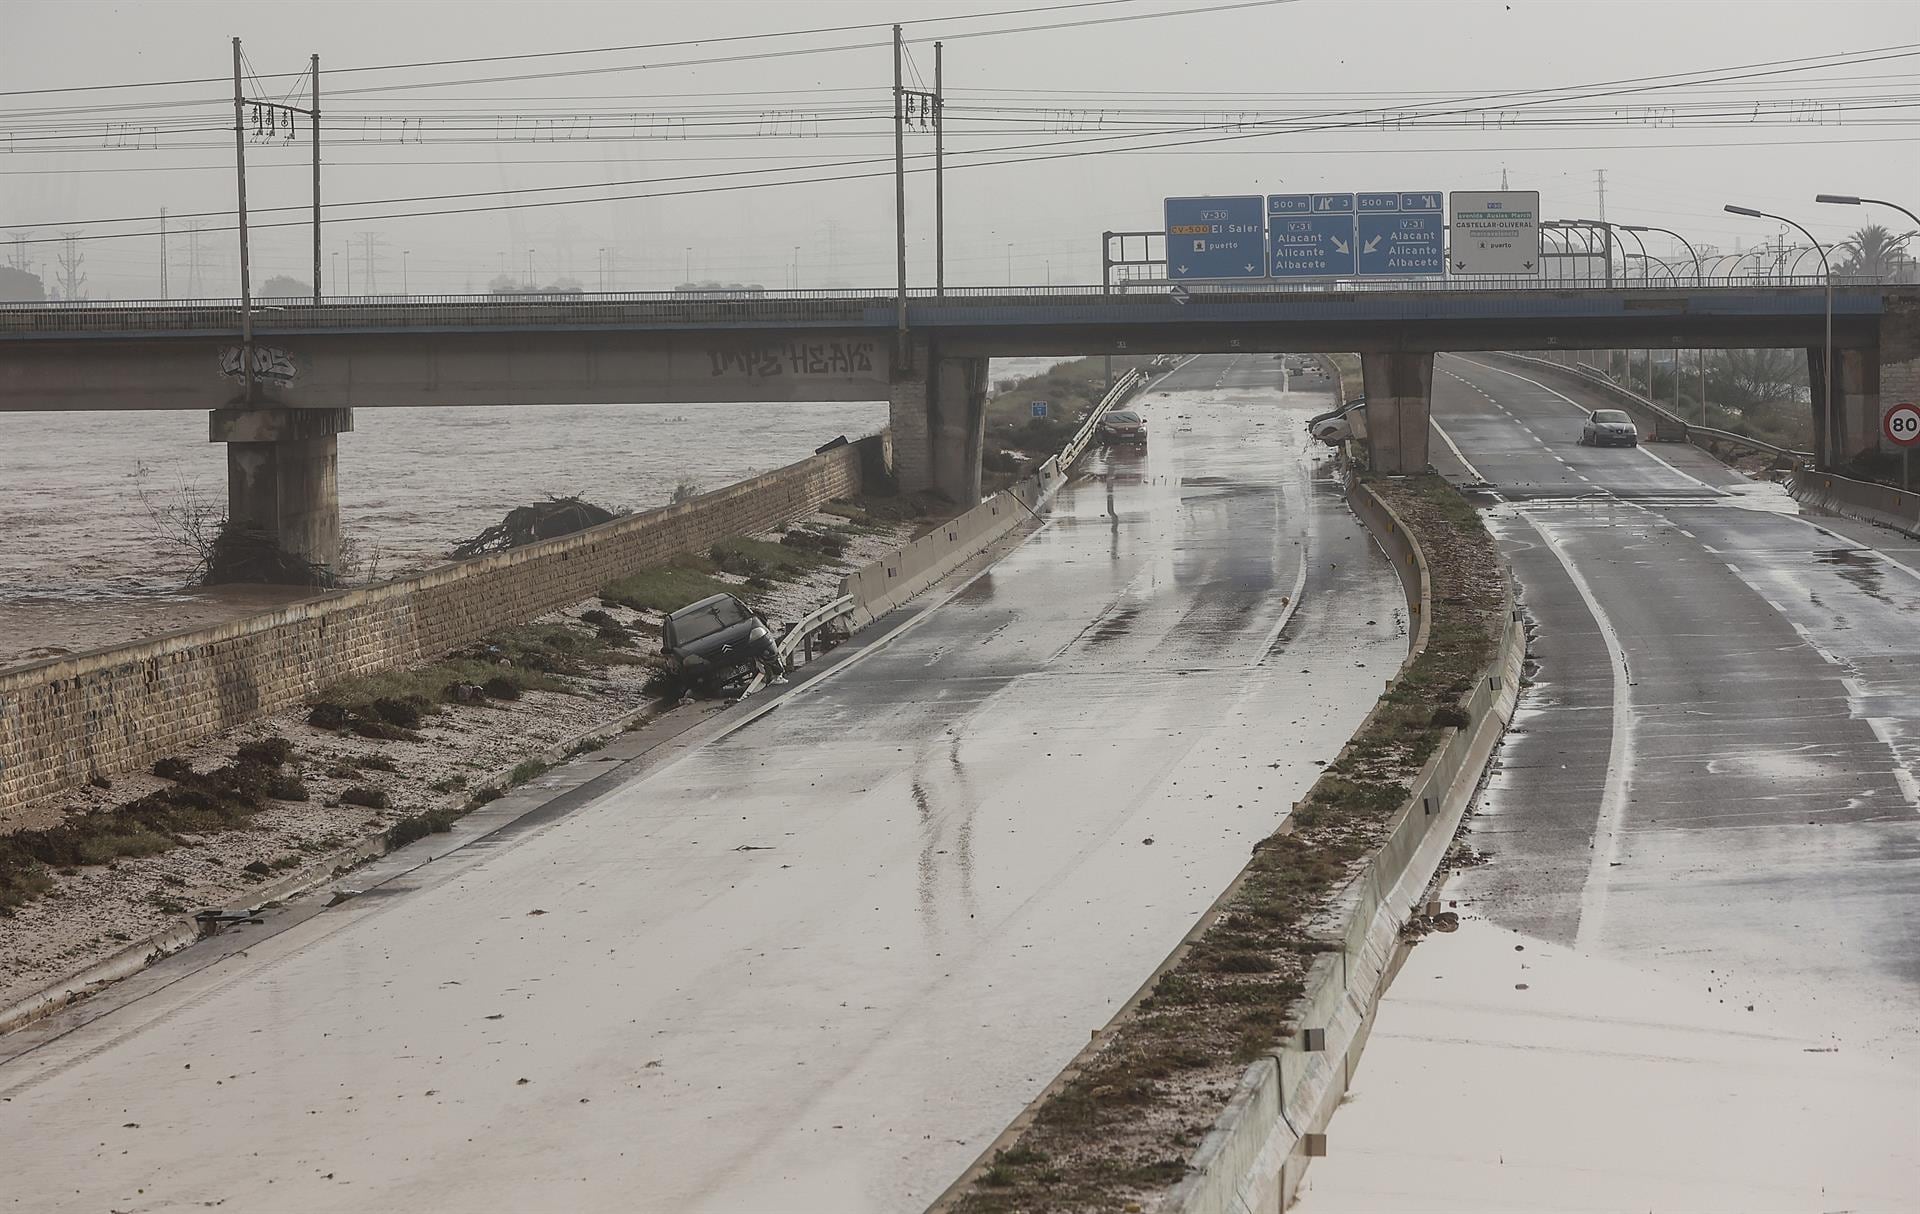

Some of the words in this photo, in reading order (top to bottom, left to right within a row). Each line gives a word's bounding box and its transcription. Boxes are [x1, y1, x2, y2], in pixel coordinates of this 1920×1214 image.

[1273, 201, 1293, 209] 500
[1342, 199, 1348, 207] 3
[1362, 199, 1382, 207] 500
[1406, 198, 1412, 206] 3
[1202, 211, 1227, 219] V-30
[1171, 226, 1208, 234] CV-500
[1211, 225, 1223, 233] El
[1229, 224, 1259, 233] Saler
[1289, 223, 1311, 231] V-31
[1402, 220, 1424, 229] V-31
[1278, 233, 1322, 243] Alacant
[1390, 231, 1435, 241] Alacant
[1209, 241, 1238, 250] puerto
[1490, 242, 1512, 250] puerto
[1276, 248, 1325, 257] Alicante
[1388, 246, 1437, 256] Alicante
[1276, 260, 1326, 270] Albacete
[1388, 258, 1439, 268] Albacete
[1893, 418, 1918, 432] 80
